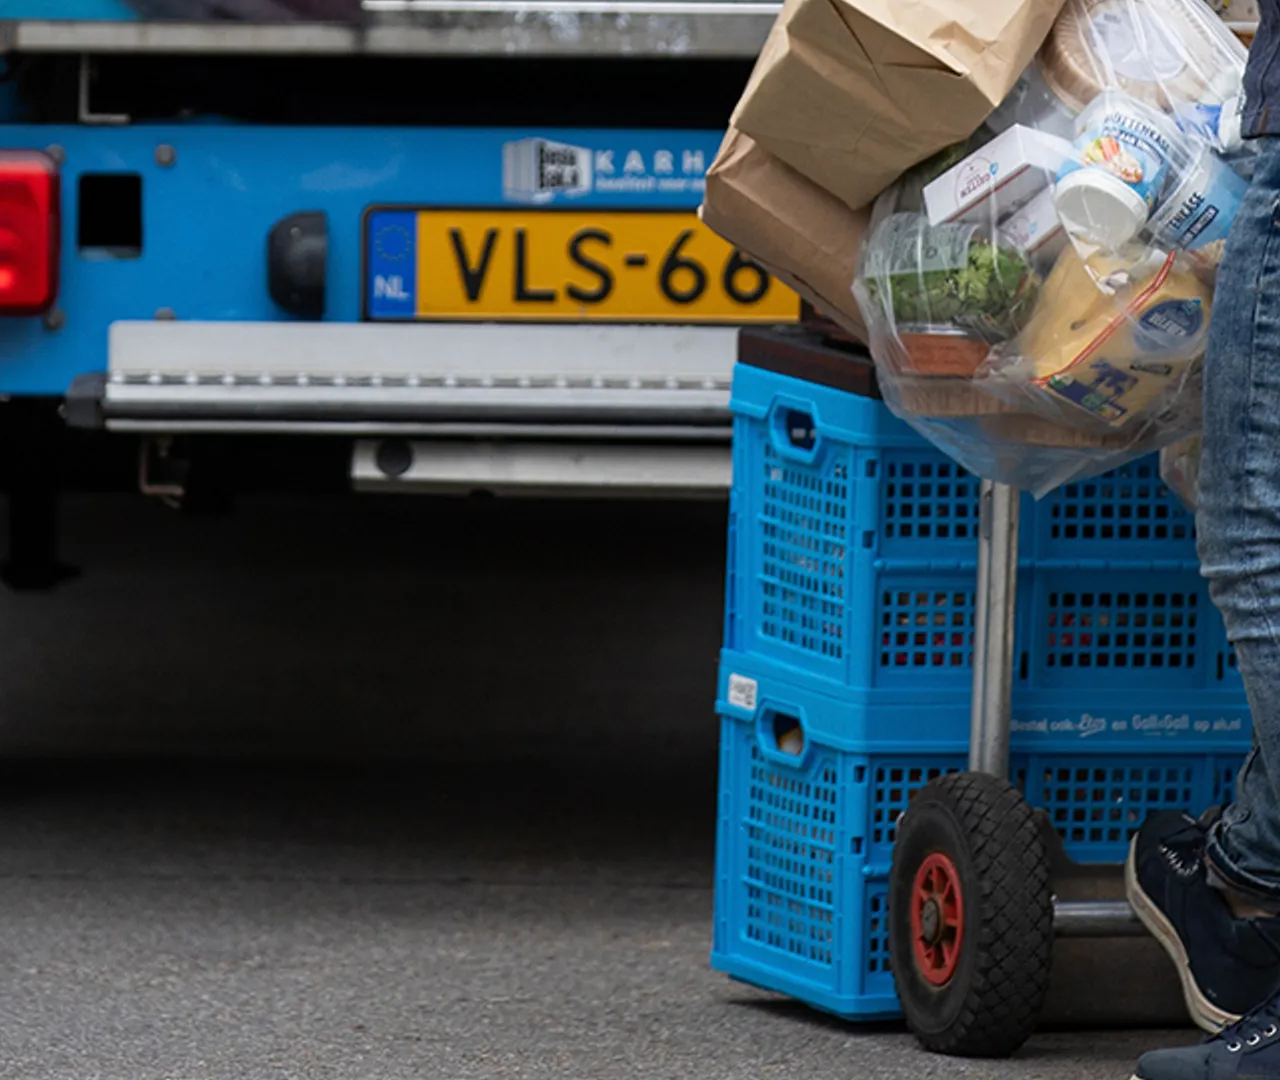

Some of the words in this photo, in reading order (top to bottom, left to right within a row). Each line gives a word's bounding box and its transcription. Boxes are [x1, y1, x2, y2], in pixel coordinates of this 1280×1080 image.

[595, 149, 704, 174] KARH
[448, 226, 770, 304] VLS-66
[373, 274, 410, 301] NL
